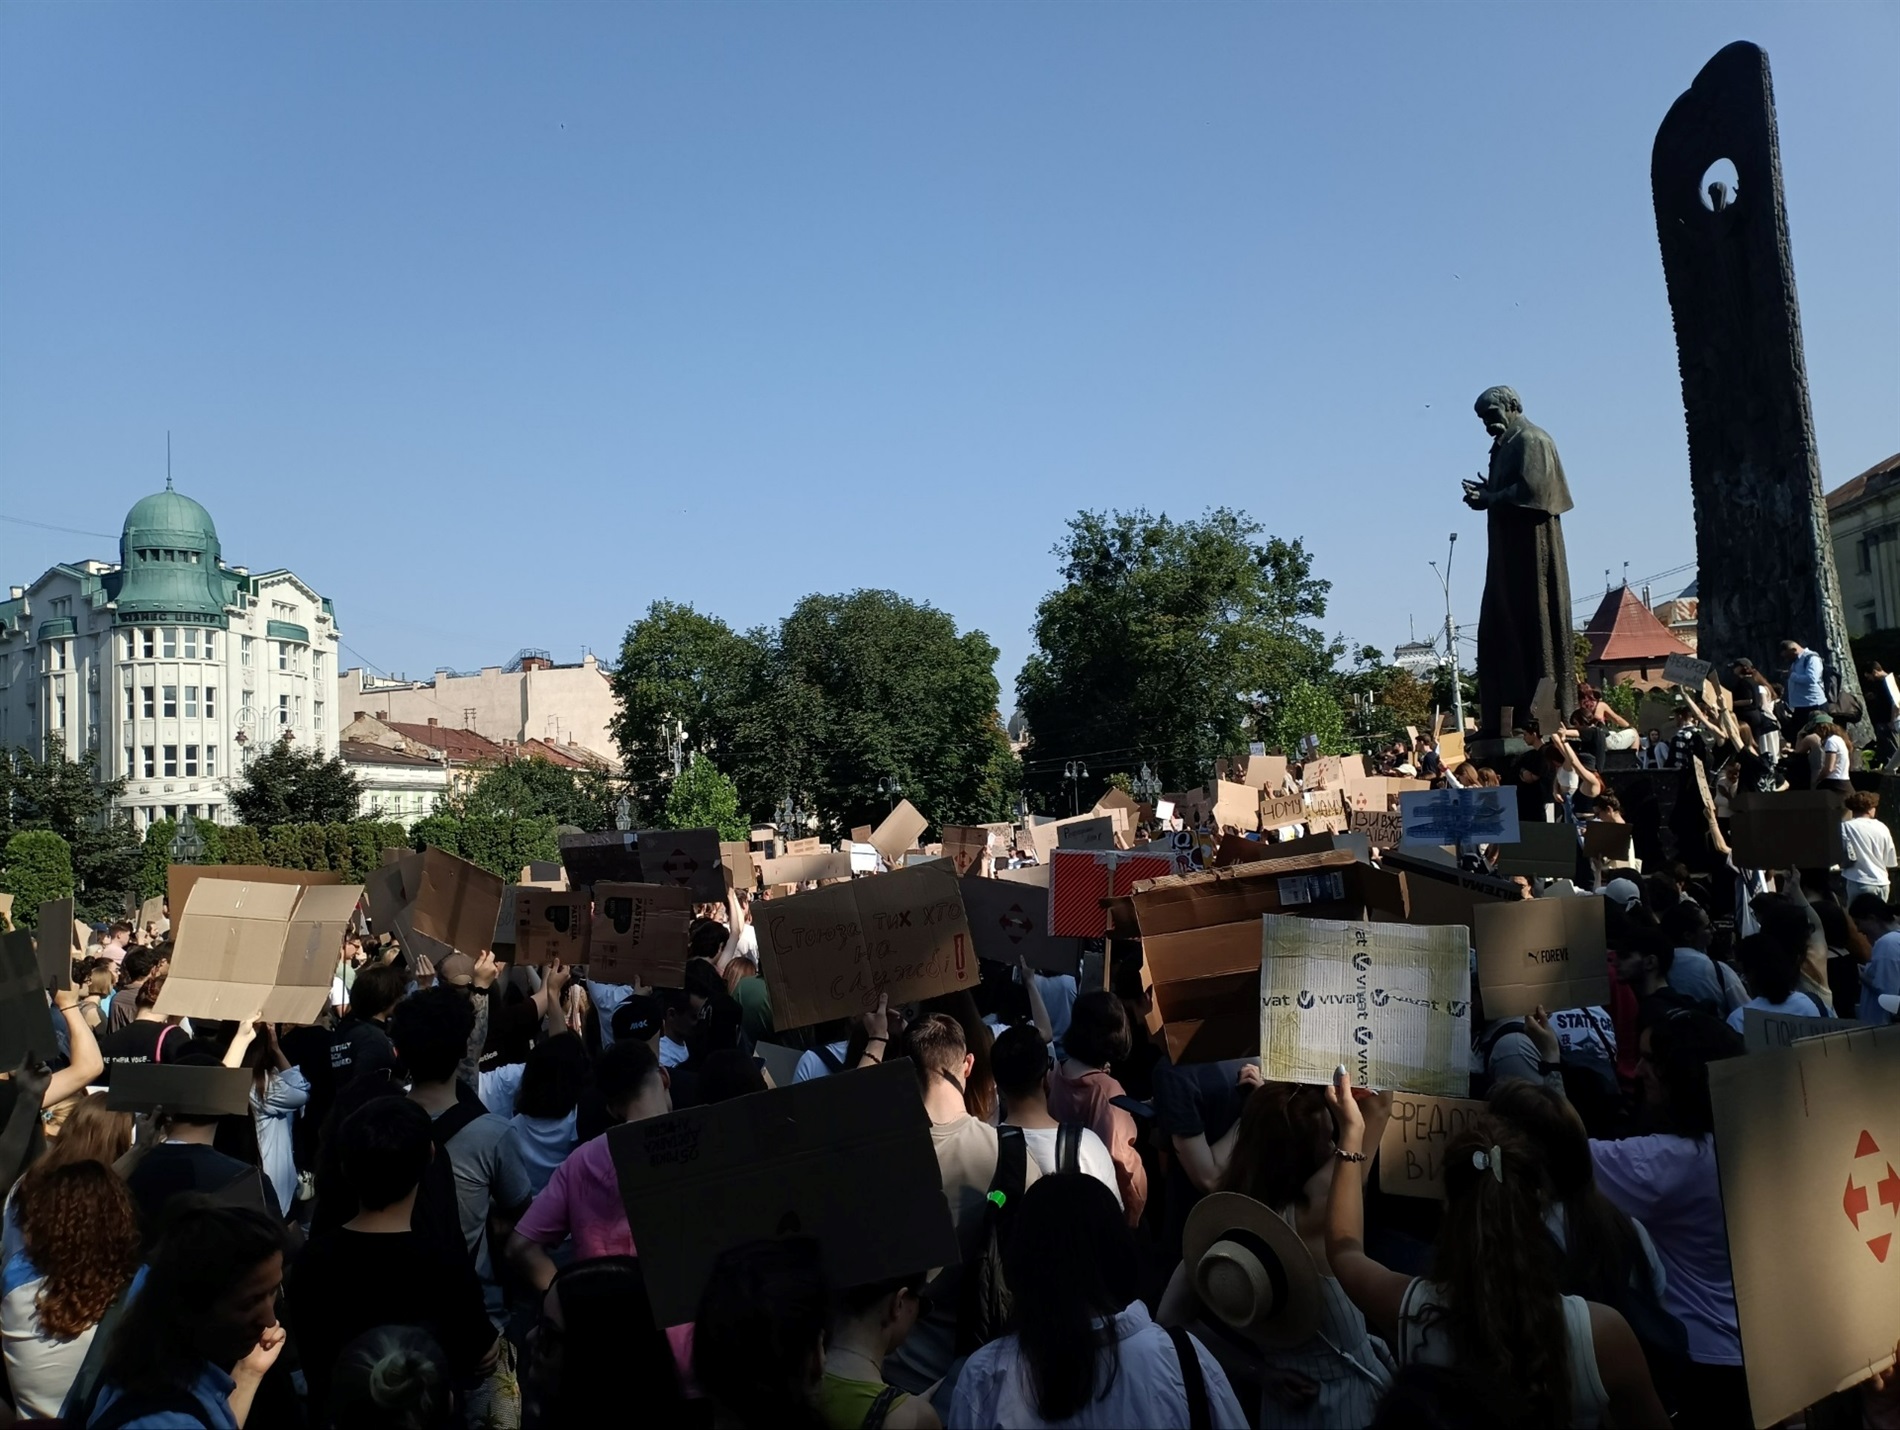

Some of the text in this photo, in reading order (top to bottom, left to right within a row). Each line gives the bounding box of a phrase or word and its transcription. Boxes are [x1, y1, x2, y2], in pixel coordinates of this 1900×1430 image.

[175, 612, 216, 624] ЦЕНТР
[1263, 799, 1303, 820] ЧОМУ
[1355, 811, 1379, 827] ВИ
[1381, 814, 1402, 830] ВЖЕ
[632, 897, 643, 946] PASTELIA
[1355, 928, 1368, 947] at
